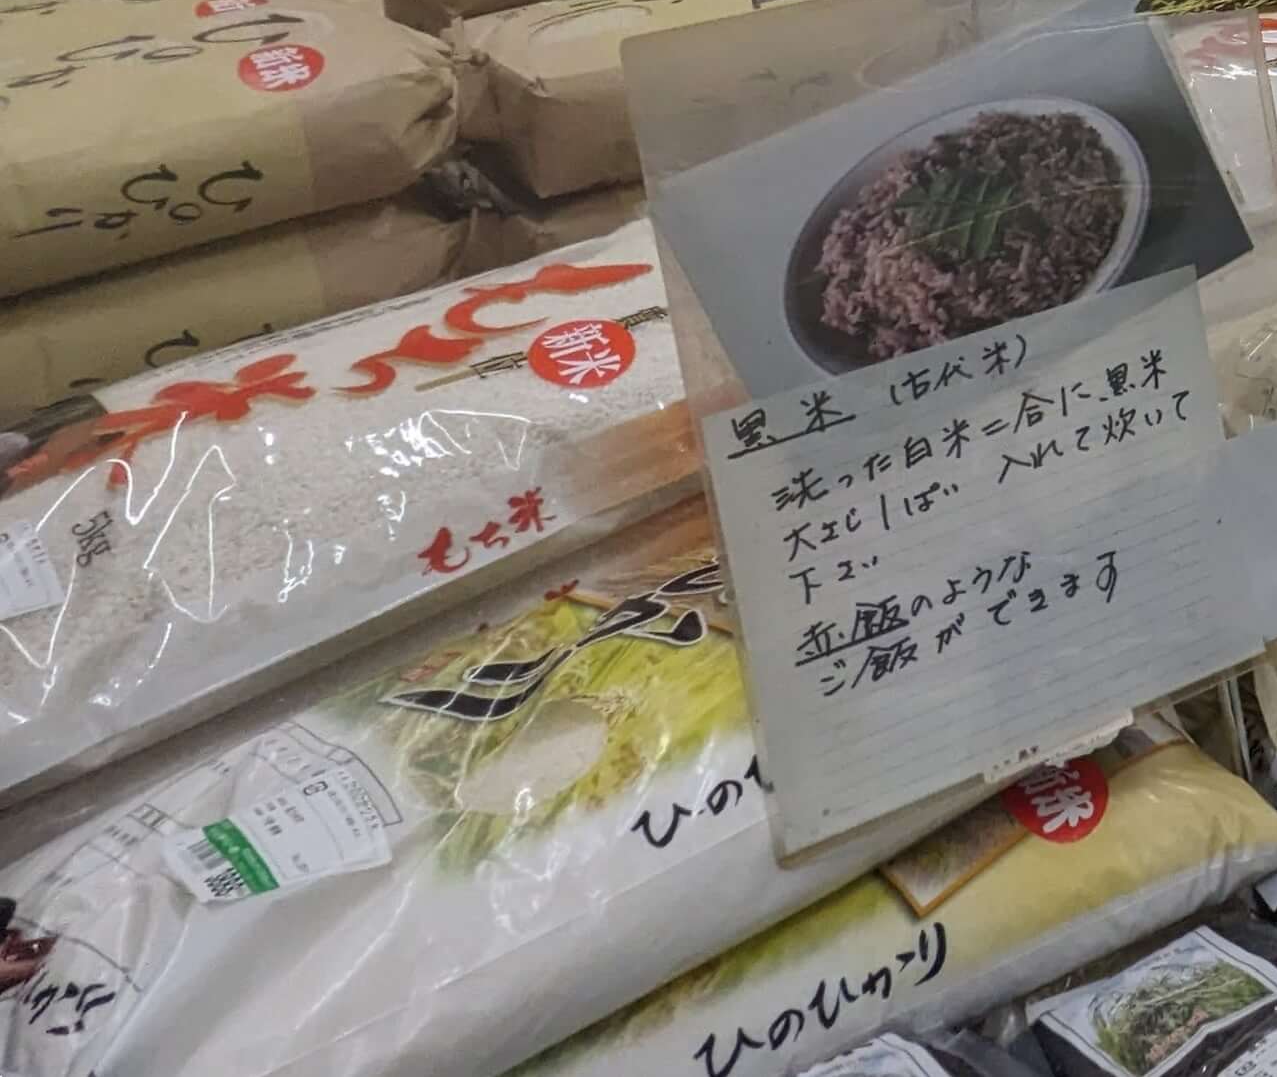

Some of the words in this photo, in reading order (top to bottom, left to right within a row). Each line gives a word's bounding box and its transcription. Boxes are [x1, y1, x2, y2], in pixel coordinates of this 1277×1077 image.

[249, 45, 312, 91] 新米
[543, 324, 622, 385] 新米
[417, 487, 555, 576] もち米
[693, 923, 948, 1077] ひのひかり
